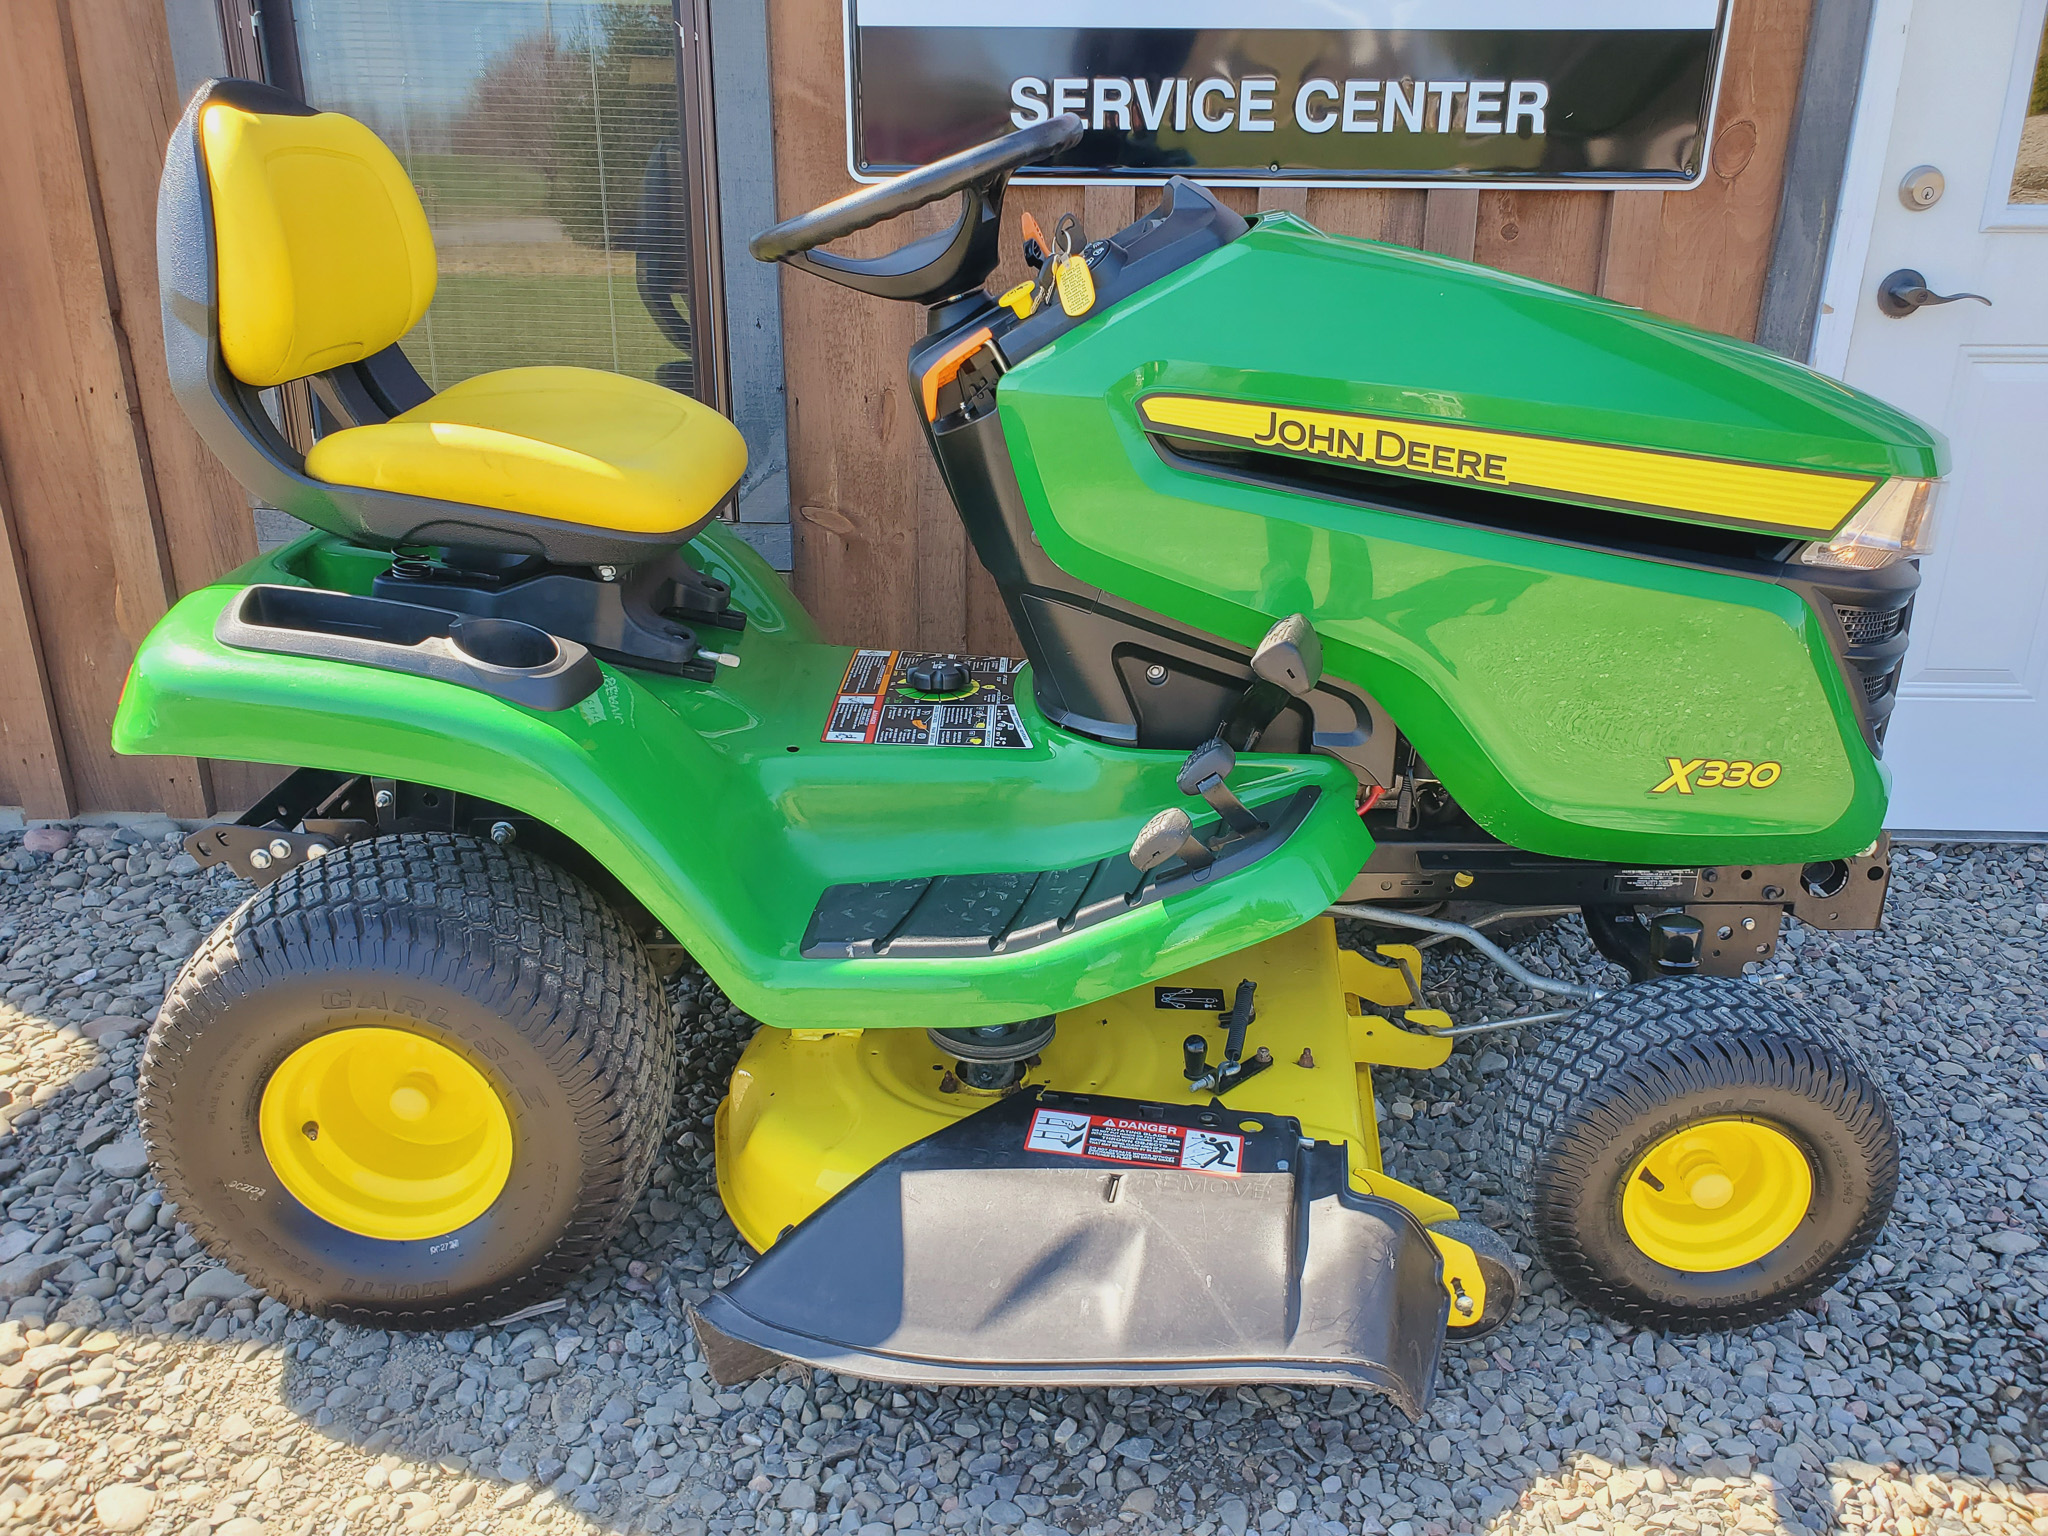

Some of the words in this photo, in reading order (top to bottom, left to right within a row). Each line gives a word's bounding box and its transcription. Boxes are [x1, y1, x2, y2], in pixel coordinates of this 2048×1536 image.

[1009, 77, 1276, 134] SERVICE
[1295, 78, 1549, 134] CENTER
[1254, 411, 1364, 457] JOHN
[1376, 429, 1507, 481] DEERE
[1647, 757, 1782, 795] X330
[1119, 1120, 1177, 1134] DANGER
